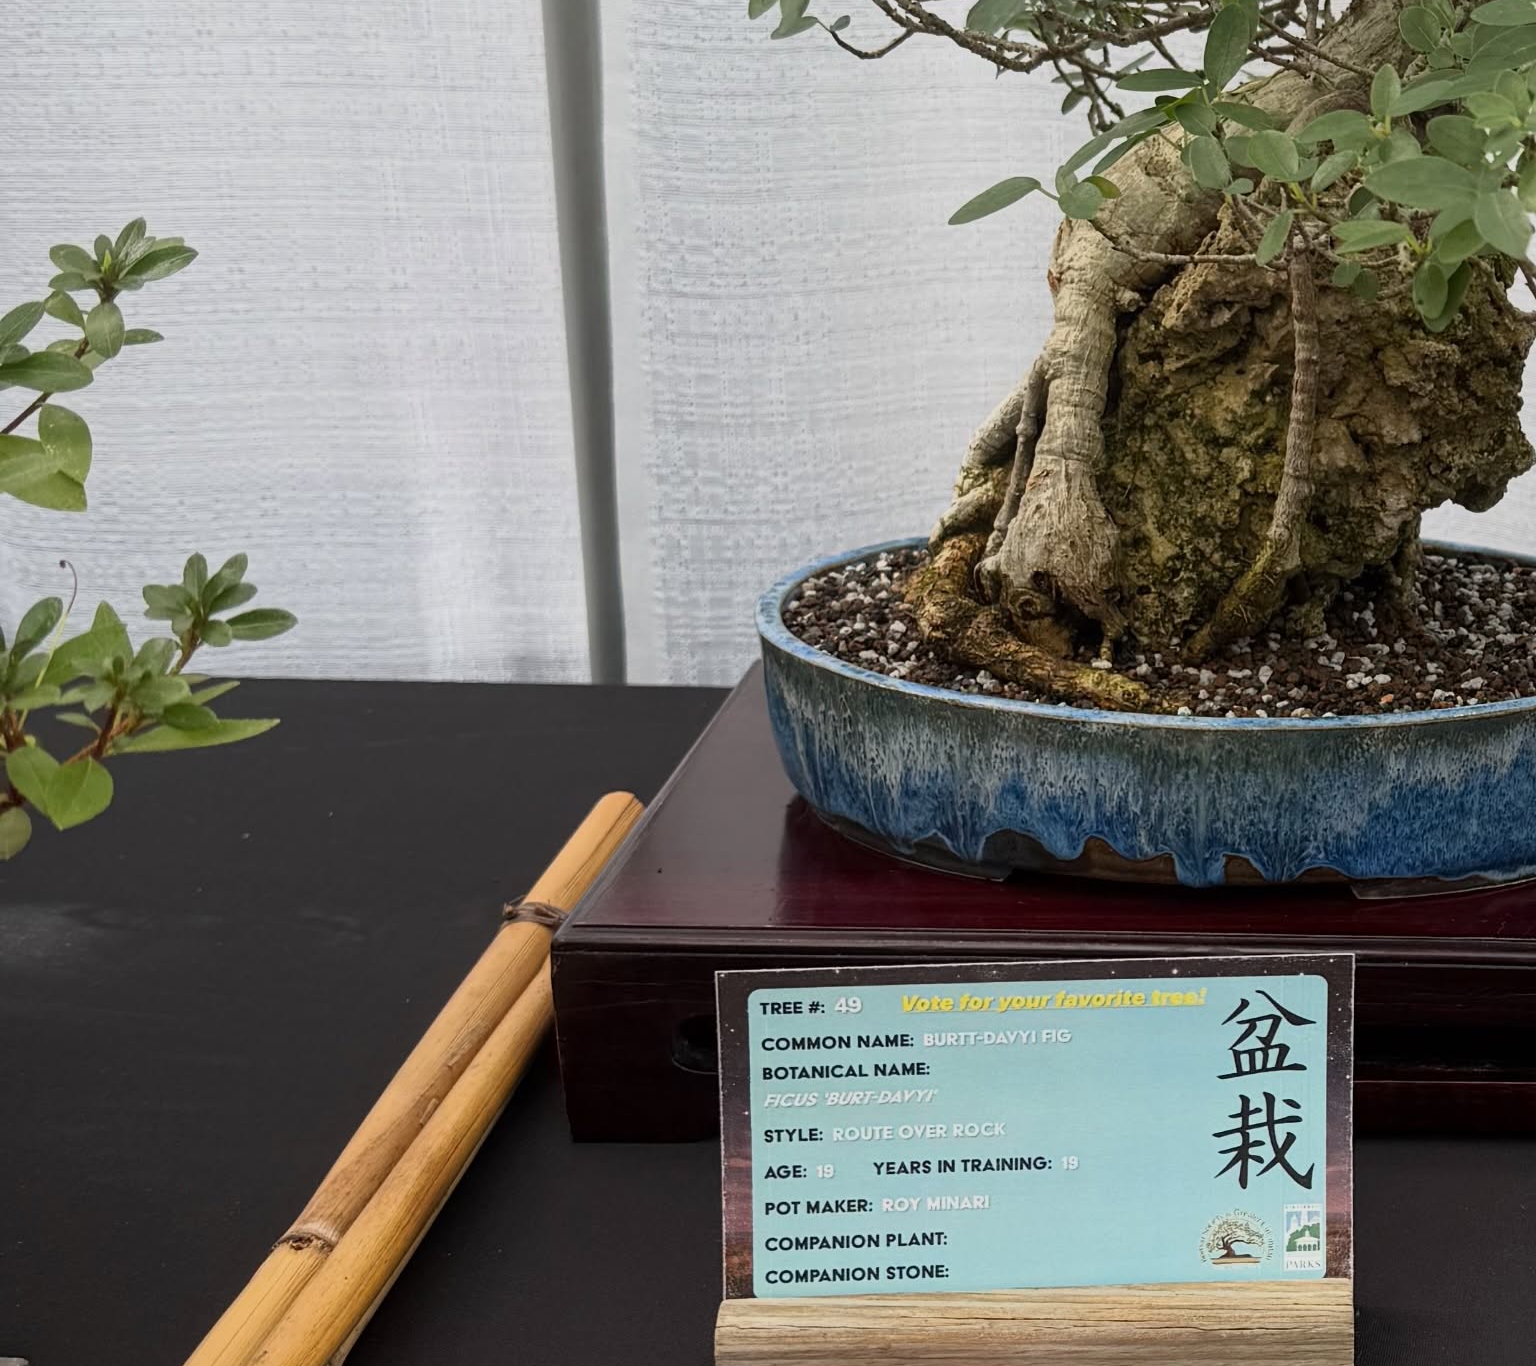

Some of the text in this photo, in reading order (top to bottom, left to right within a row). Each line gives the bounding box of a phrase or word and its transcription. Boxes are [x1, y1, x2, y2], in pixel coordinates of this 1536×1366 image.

[760, 997, 863, 1015] TREE #: 49
[902, 988, 1208, 1013] Vote for your favorite tree!
[761, 1029, 1072, 1051] COMMON NAME: BURTT-DAVYI FIG
[762, 1062, 930, 1080] BOTANICAL NAME:
[1212, 989, 1317, 1190] 盆栽
[764, 1092, 818, 1108] FICUS
[764, 1122, 1006, 1143] STYLE: ROUTE OVER ROCK
[764, 1163, 835, 1179] AGE: 19
[873, 1155, 1080, 1176] YEARS IN TRAINING: 19
[765, 1195, 990, 1215] POT MAKER: ROY MINARI
[764, 1232, 948, 1252] COMPANION PLANT:
[1286, 1259, 1321, 1269] PARKS
[765, 1264, 949, 1285] COMPANION STONE:
